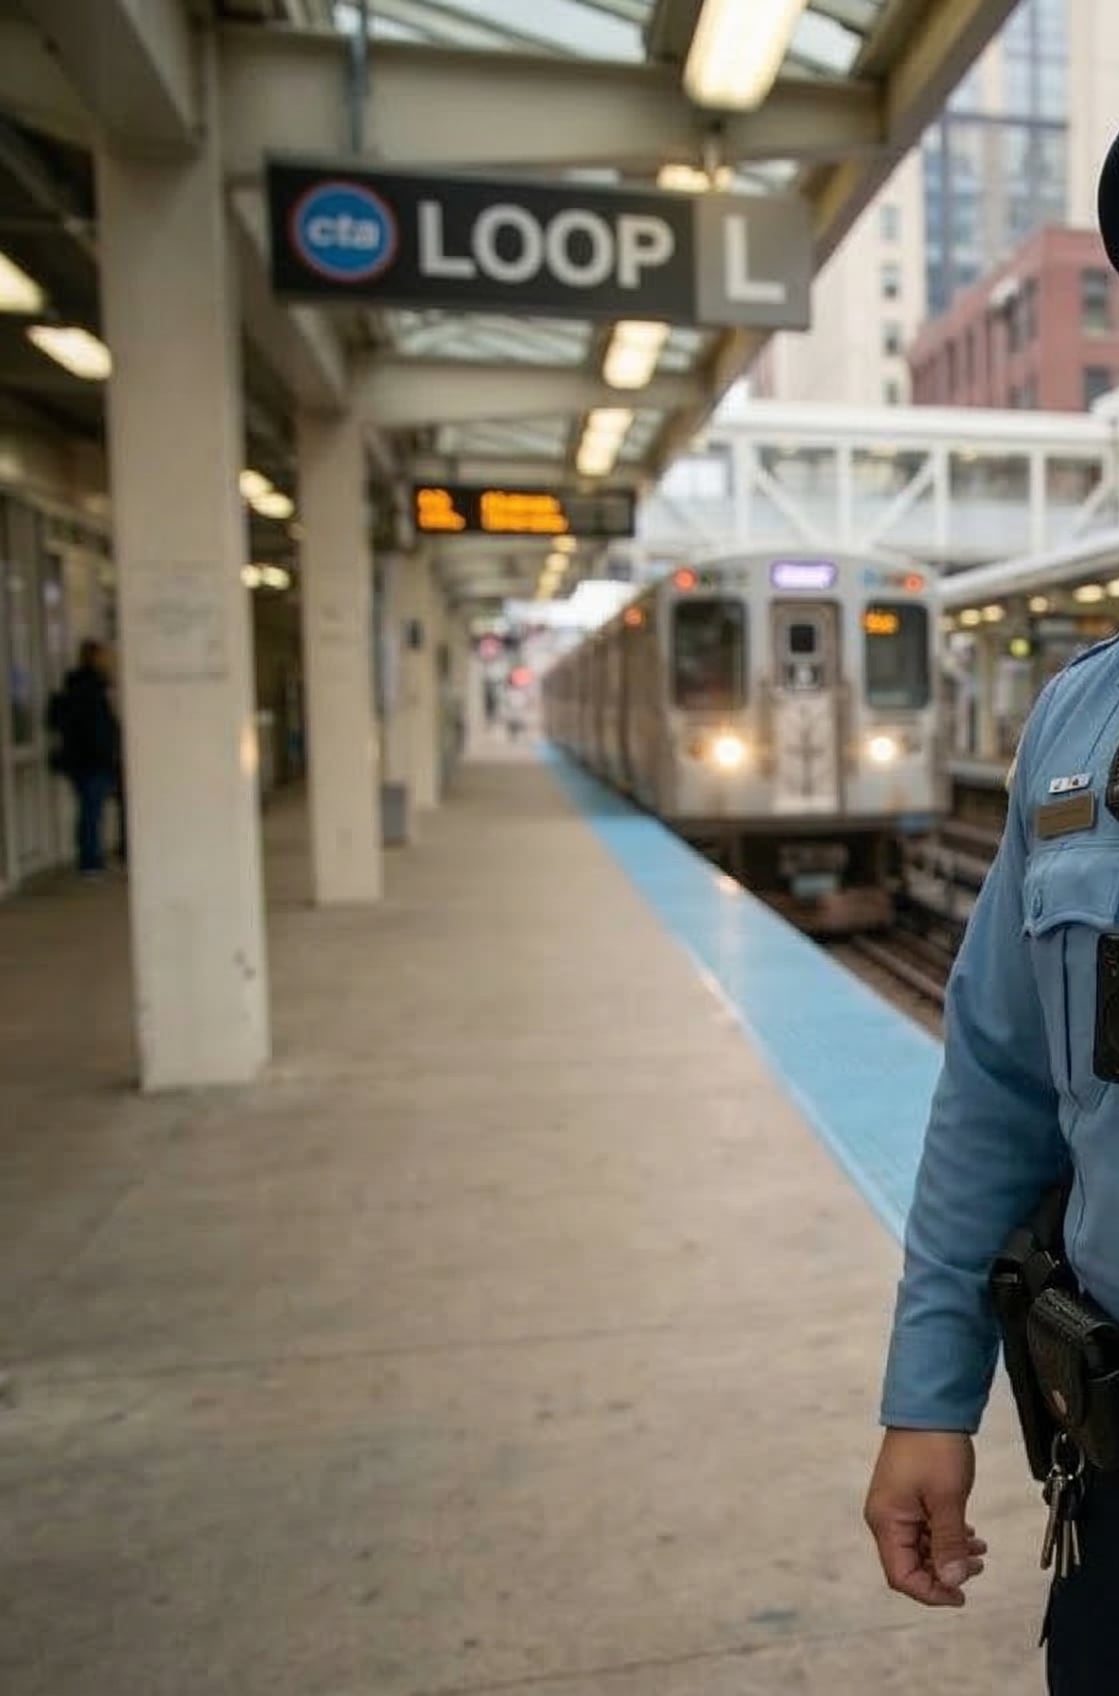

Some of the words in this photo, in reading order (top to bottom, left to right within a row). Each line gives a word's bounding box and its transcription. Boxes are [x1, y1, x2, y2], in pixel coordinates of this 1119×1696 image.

[307, 213, 382, 249] cta
[416, 200, 676, 289] LOOP
[722, 214, 788, 305] L
